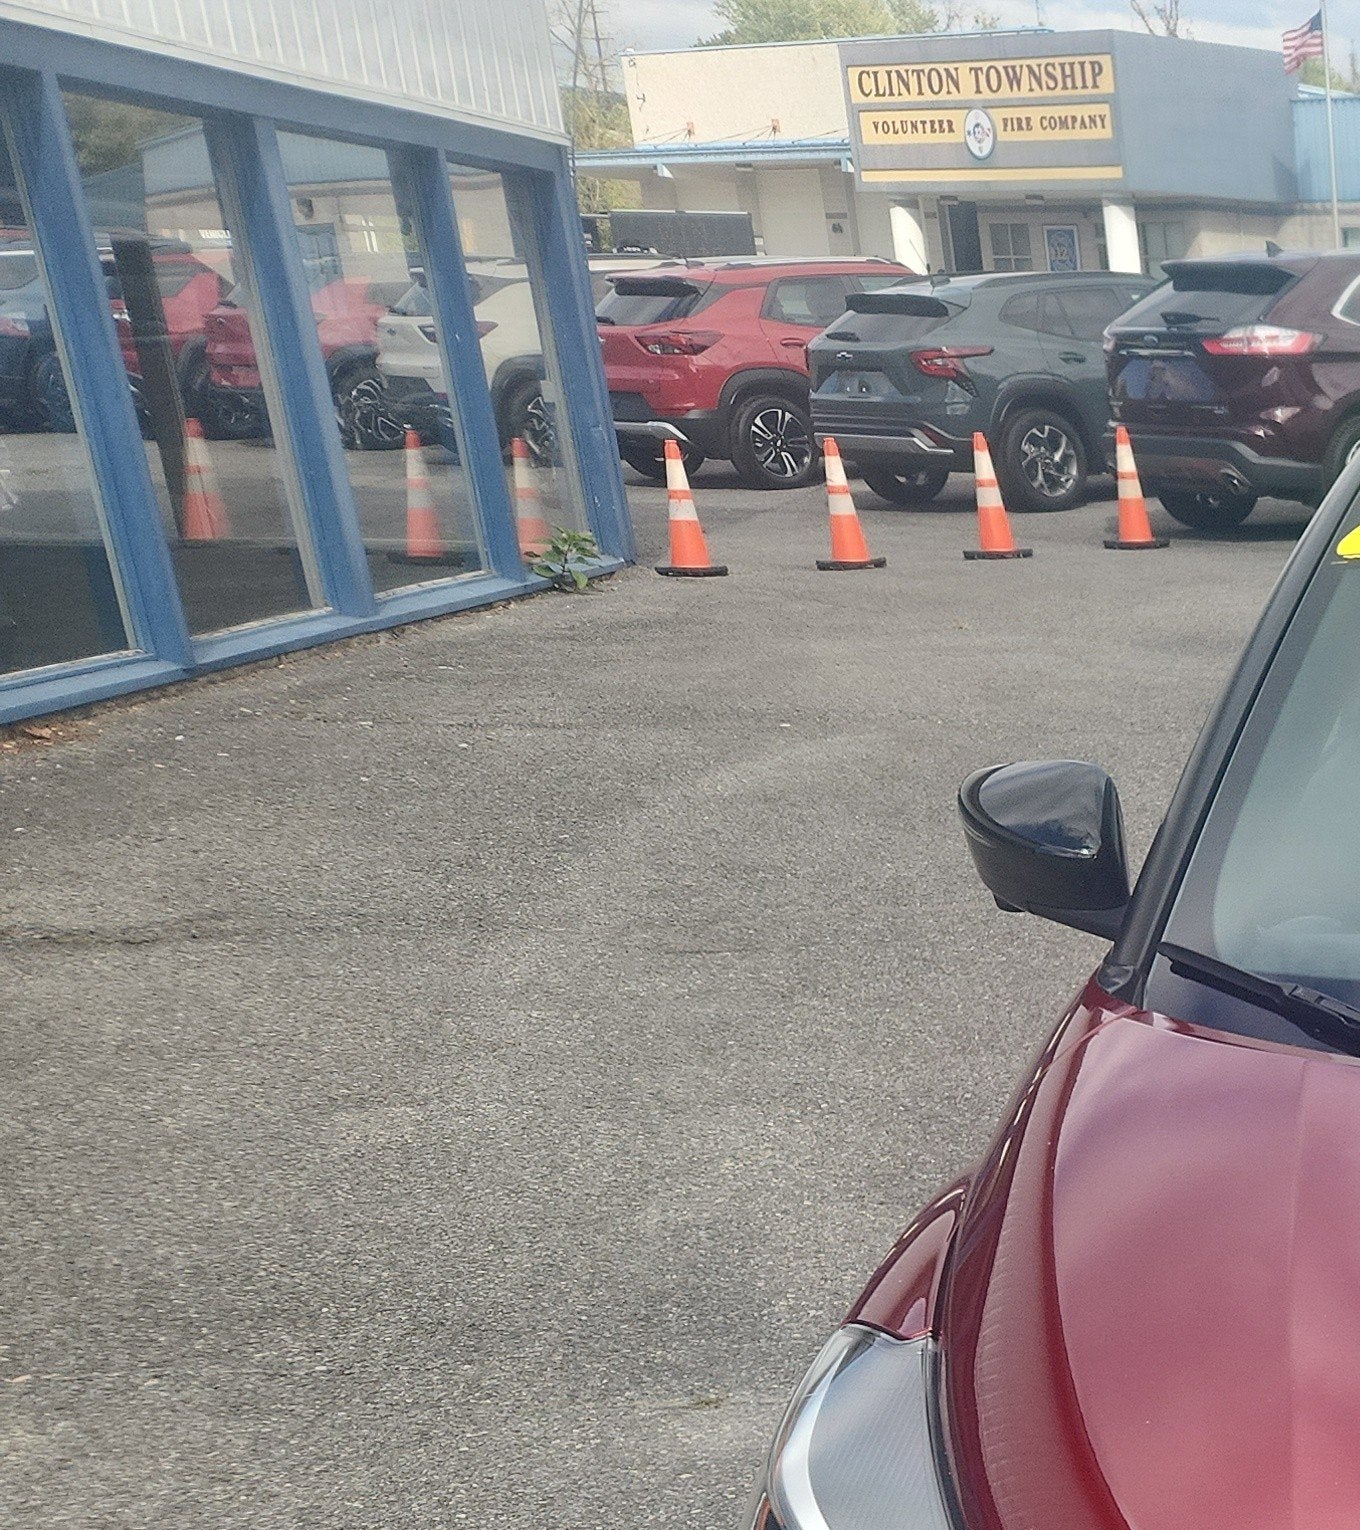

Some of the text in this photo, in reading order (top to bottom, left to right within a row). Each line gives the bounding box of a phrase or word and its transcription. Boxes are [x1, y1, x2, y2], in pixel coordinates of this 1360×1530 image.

[857, 60, 1103, 97] CLINTON TOWNSHIP
[872, 113, 1107, 135] VOLUNTEER FIRE COMPANY
